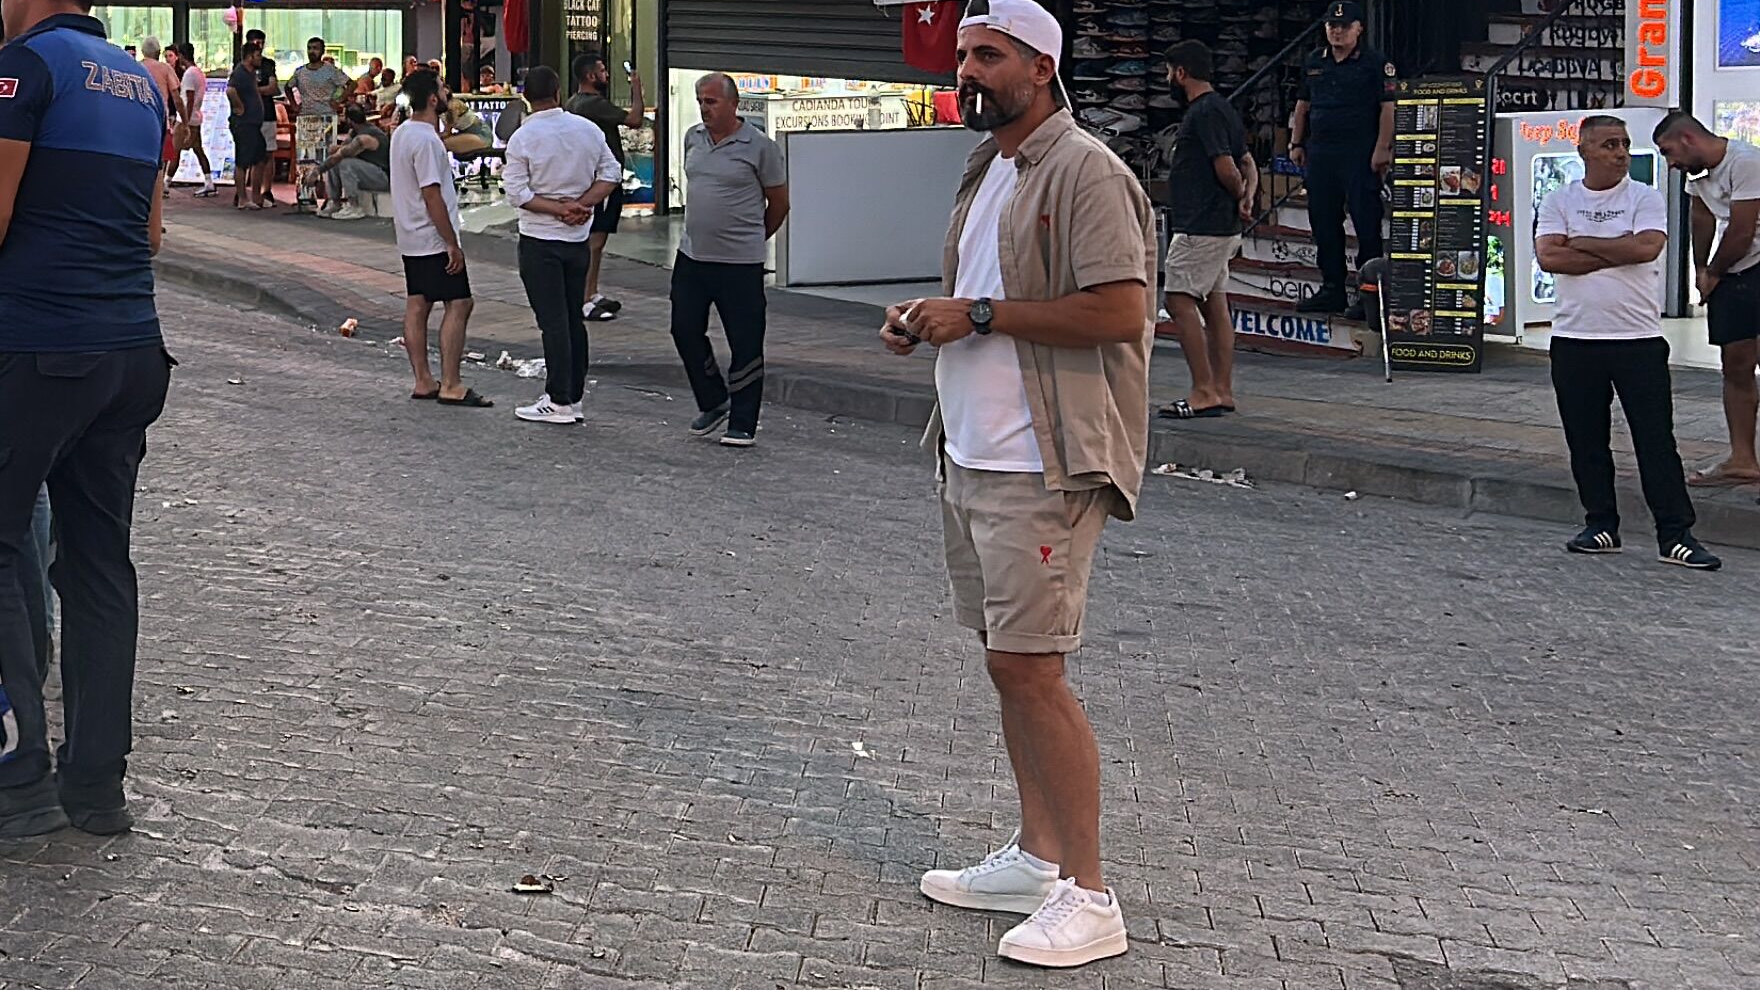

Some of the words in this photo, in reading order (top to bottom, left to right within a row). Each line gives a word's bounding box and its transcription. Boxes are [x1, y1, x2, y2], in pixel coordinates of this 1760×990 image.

[566, 15, 598, 28] TATTOO
[565, 30, 598, 41] PIERCING
[81, 60, 156, 106] ZABITA
[478, 100, 510, 110] TATTO
[792, 99, 845, 111] CADIANDA
[848, 97, 872, 110] TOU
[877, 112, 901, 125] OINT
[1391, 347, 1417, 358] FOOD
[1418, 349, 1438, 359] AND
[1439, 350, 1471, 361] DRINKS
